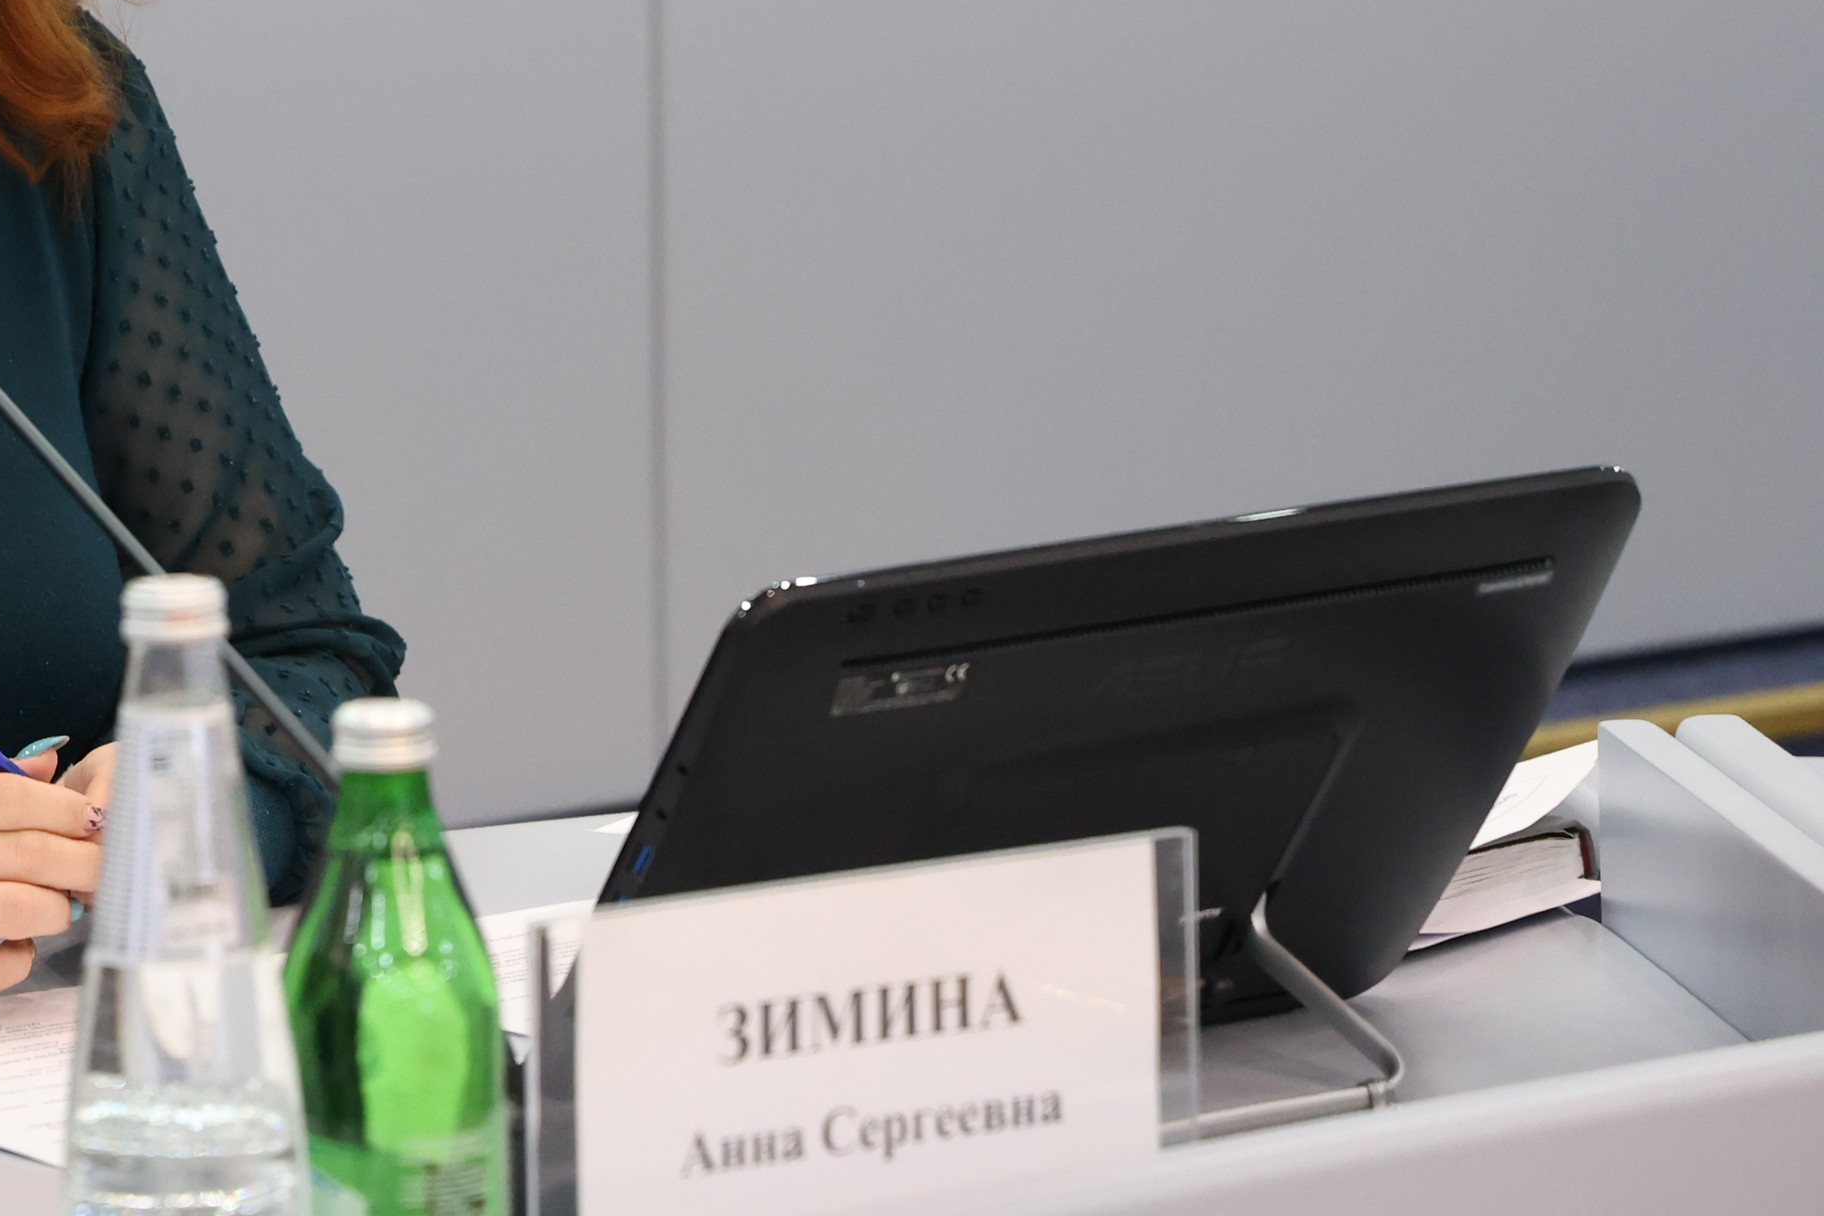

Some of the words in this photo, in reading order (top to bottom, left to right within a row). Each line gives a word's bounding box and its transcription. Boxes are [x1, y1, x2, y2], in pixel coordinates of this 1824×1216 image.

[718, 971, 1024, 1068] ЗИМИНА
[682, 1129, 805, 1178] Анна
[820, 1090, 1064, 1163] Сергеевна
